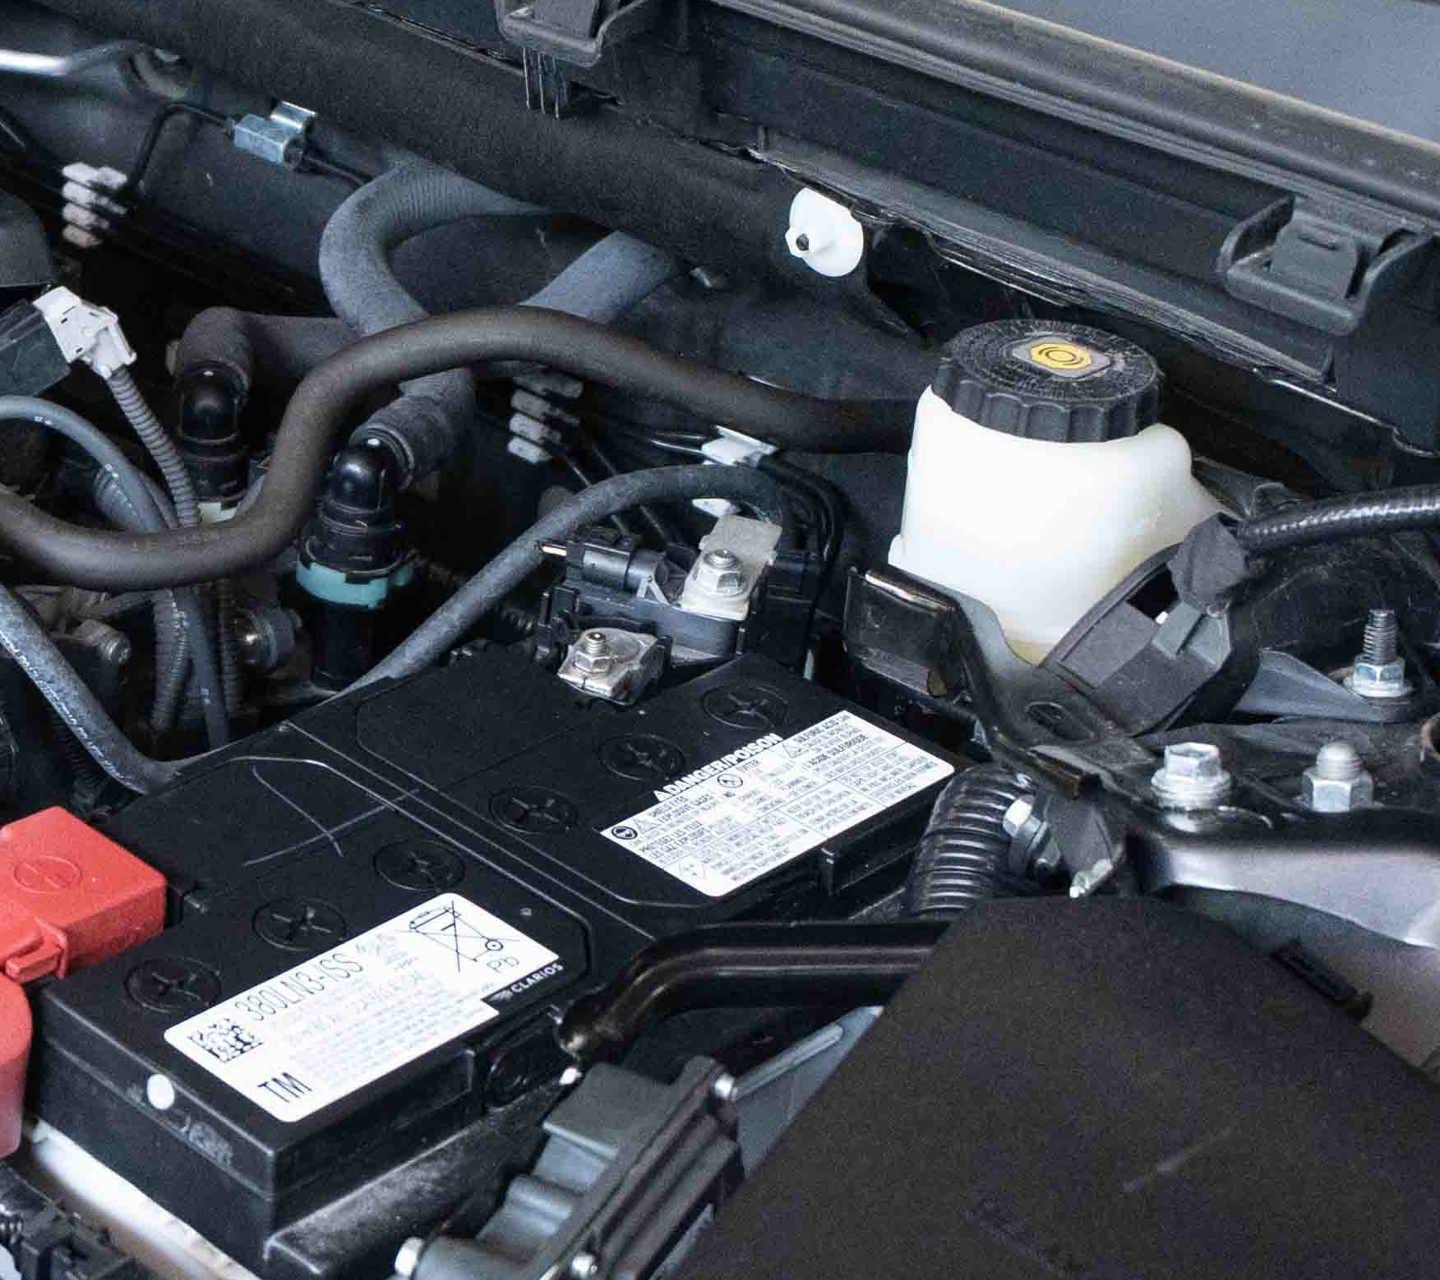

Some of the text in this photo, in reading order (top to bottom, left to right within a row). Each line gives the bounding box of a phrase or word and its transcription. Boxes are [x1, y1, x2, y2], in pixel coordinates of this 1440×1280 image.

[663, 733, 784, 796] DANGER/POISON
[510, 963, 564, 993] CLARIOS
[257, 1072, 313, 1103] TM
